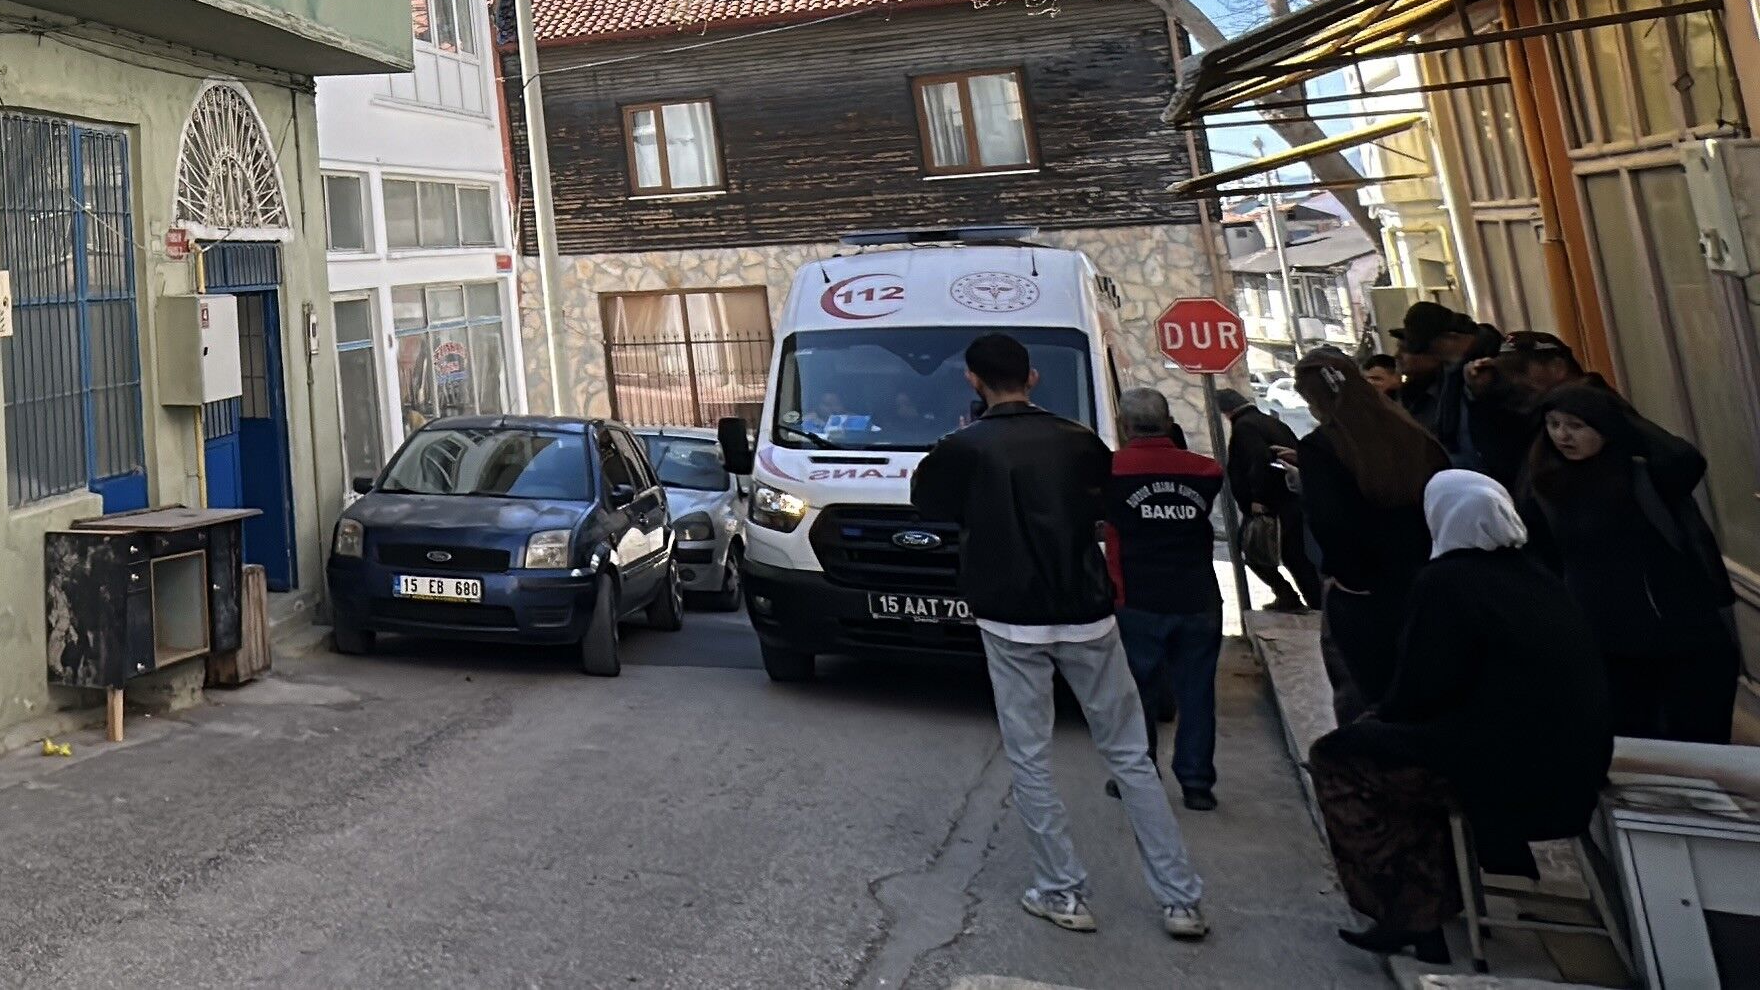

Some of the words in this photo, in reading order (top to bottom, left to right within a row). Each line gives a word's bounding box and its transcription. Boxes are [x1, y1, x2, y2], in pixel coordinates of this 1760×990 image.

[836, 286, 905, 304] 112
[1163, 321, 1239, 350] DUR
[1140, 504, 1197, 520] BAKUD
[403, 578, 418, 593] 15
[428, 579, 444, 595] EB
[455, 581, 479, 597] 680
[879, 595, 900, 614] 15
[904, 596, 939, 616] AAT
[942, 598, 971, 618] 70
